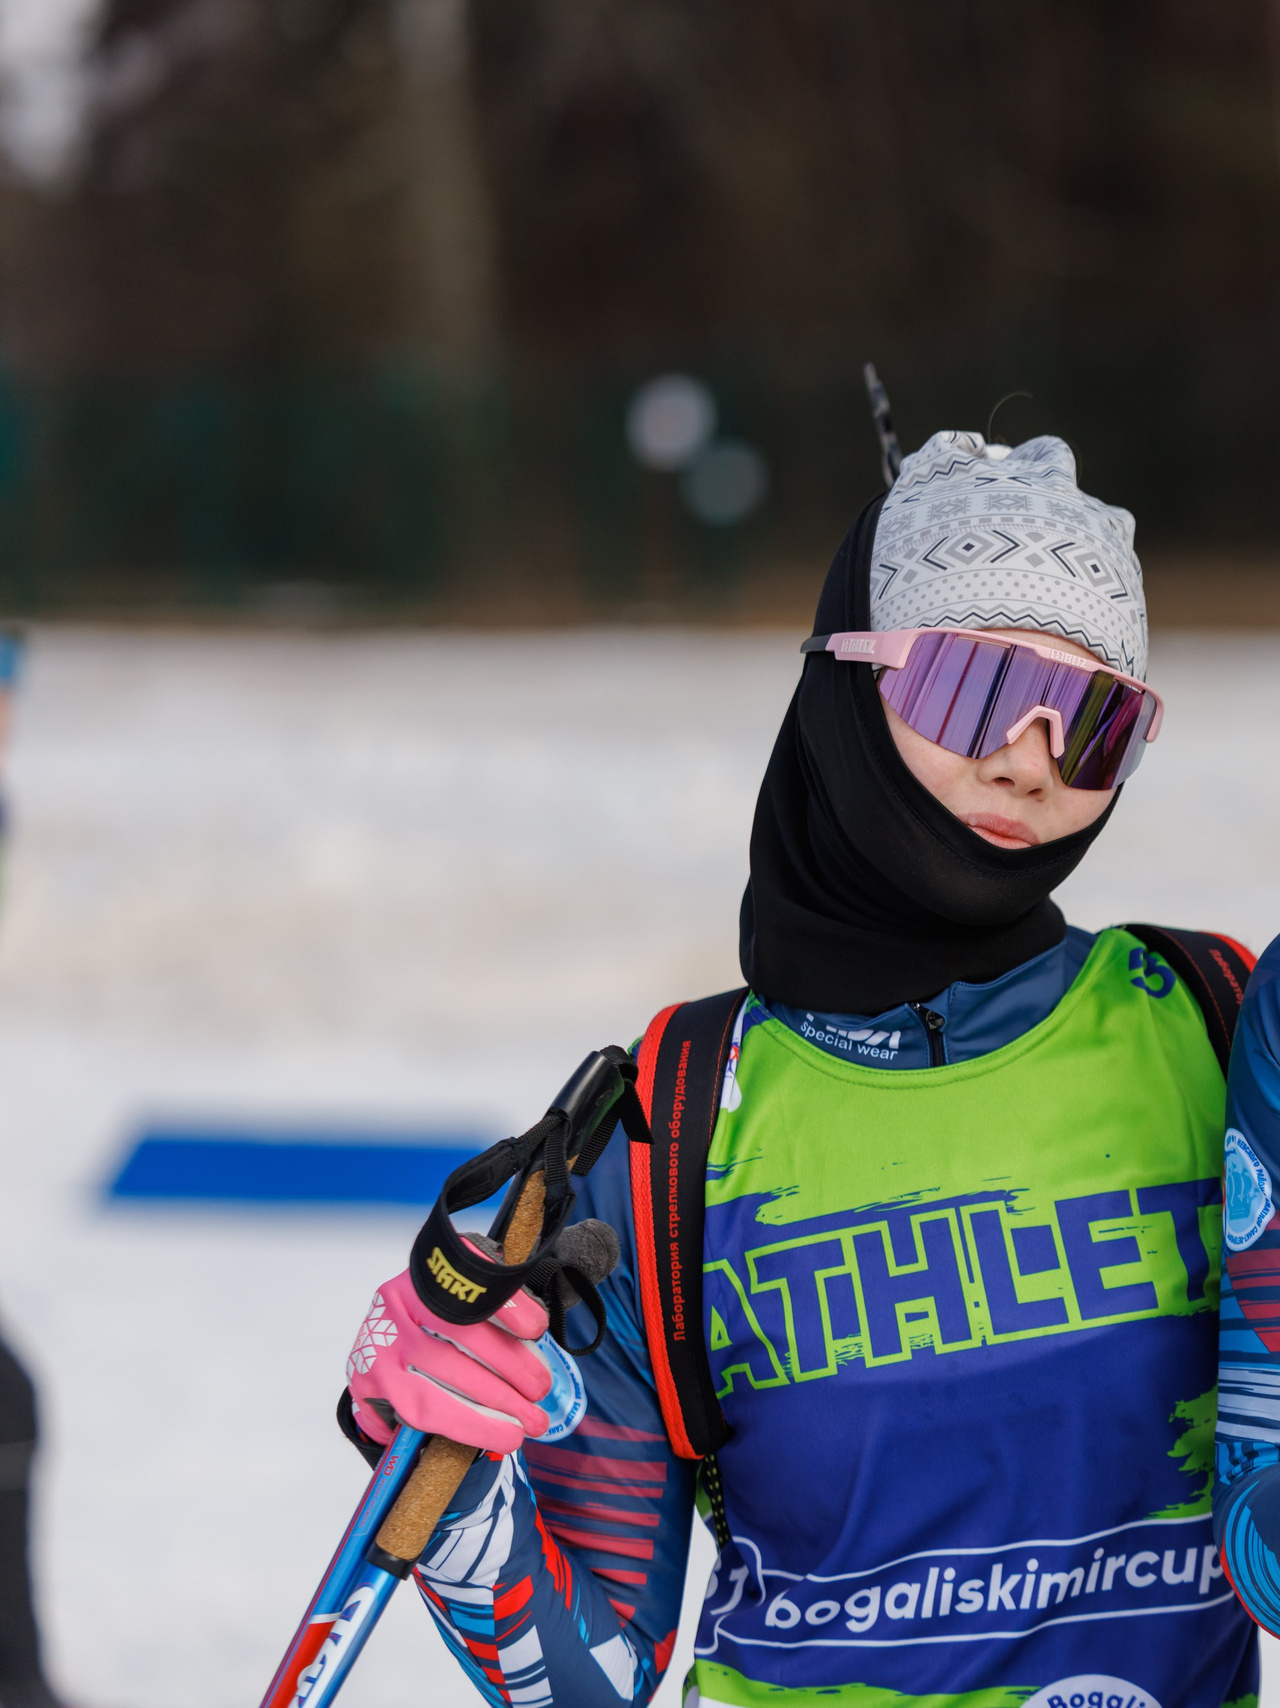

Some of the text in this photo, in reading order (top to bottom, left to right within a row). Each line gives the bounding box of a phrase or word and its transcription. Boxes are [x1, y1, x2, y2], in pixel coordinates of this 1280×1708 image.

[800, 1021, 853, 1051] special
[857, 1043, 898, 1060] wear
[669, 1040, 692, 1341] Лаборатория стрелкового оборудования
[426, 1246, 488, 1304] START
[764, 1542, 1223, 1633] bogaliskimircup
